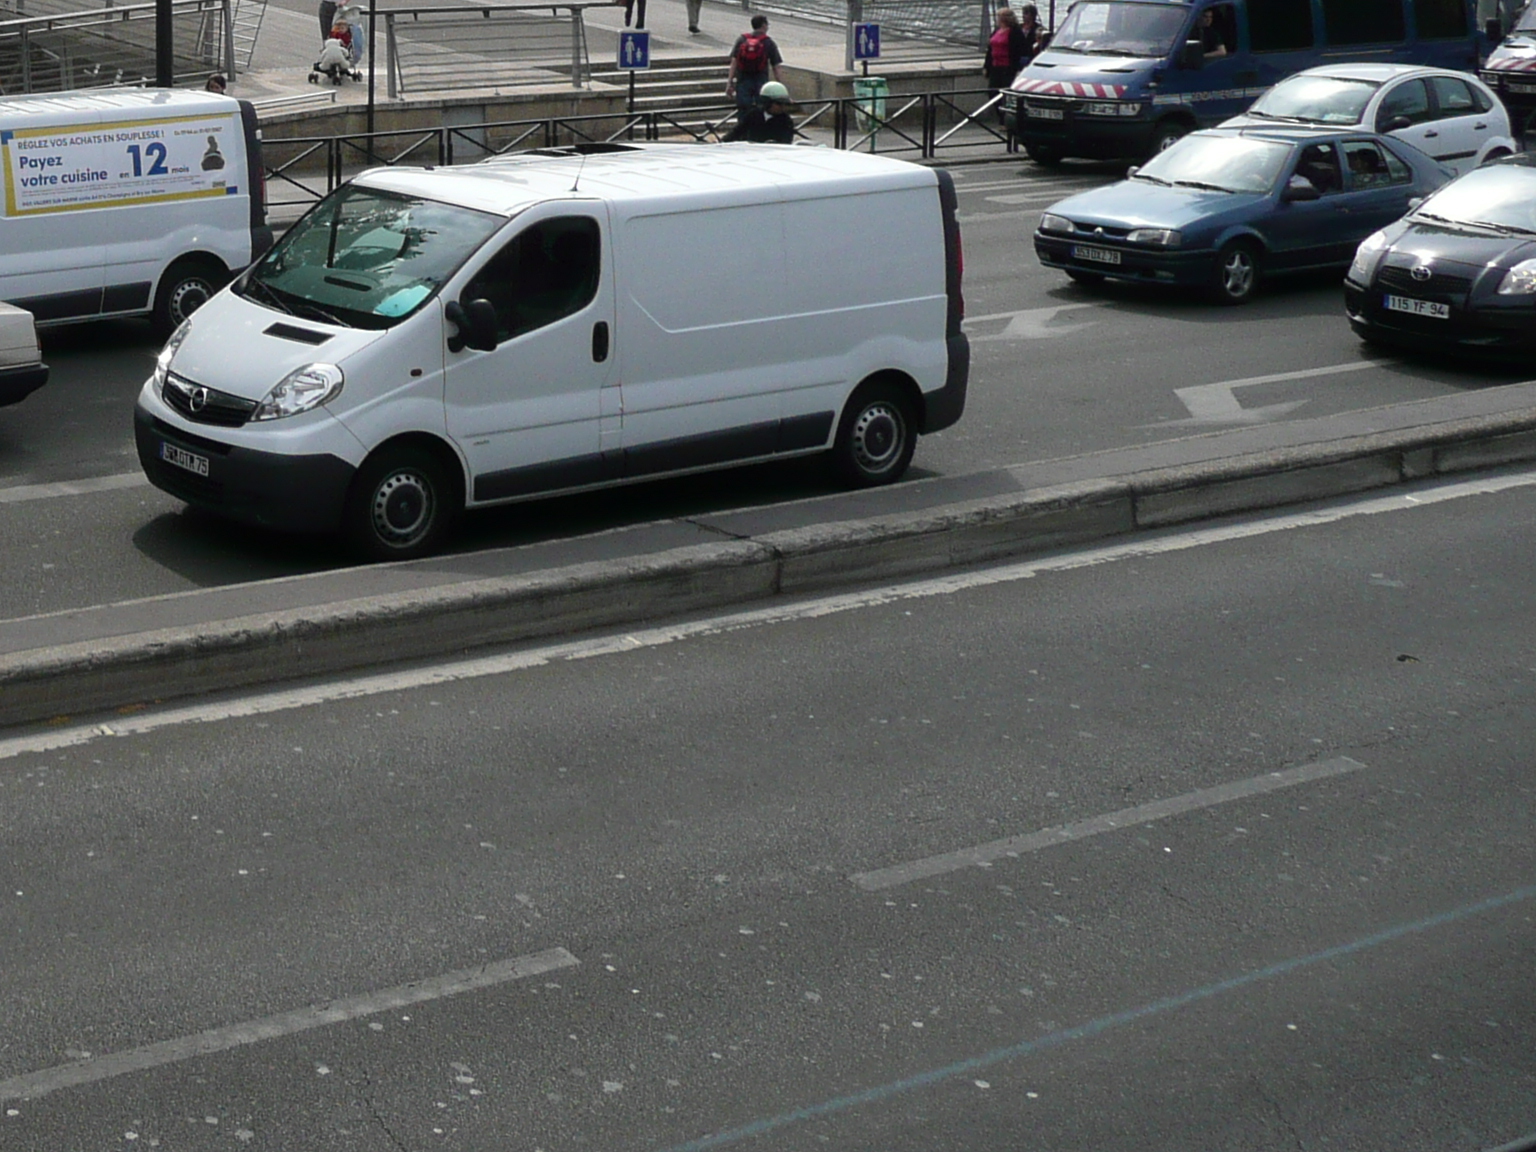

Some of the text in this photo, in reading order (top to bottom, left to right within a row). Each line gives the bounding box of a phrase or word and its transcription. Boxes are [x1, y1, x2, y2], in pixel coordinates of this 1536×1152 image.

[50, 138, 68, 148] VOS
[69, 135, 102, 146] ACHATS
[103, 134, 115, 143] EN
[115, 130, 161, 142] SOUPLESSE
[19, 156, 63, 171] Payez
[20, 141, 190, 187] votre cuisine en 12 mois
[1107, 251, 1119, 263] 78
[1391, 297, 1445, 315] 115 YF 94
[195, 457, 207, 474] 75
